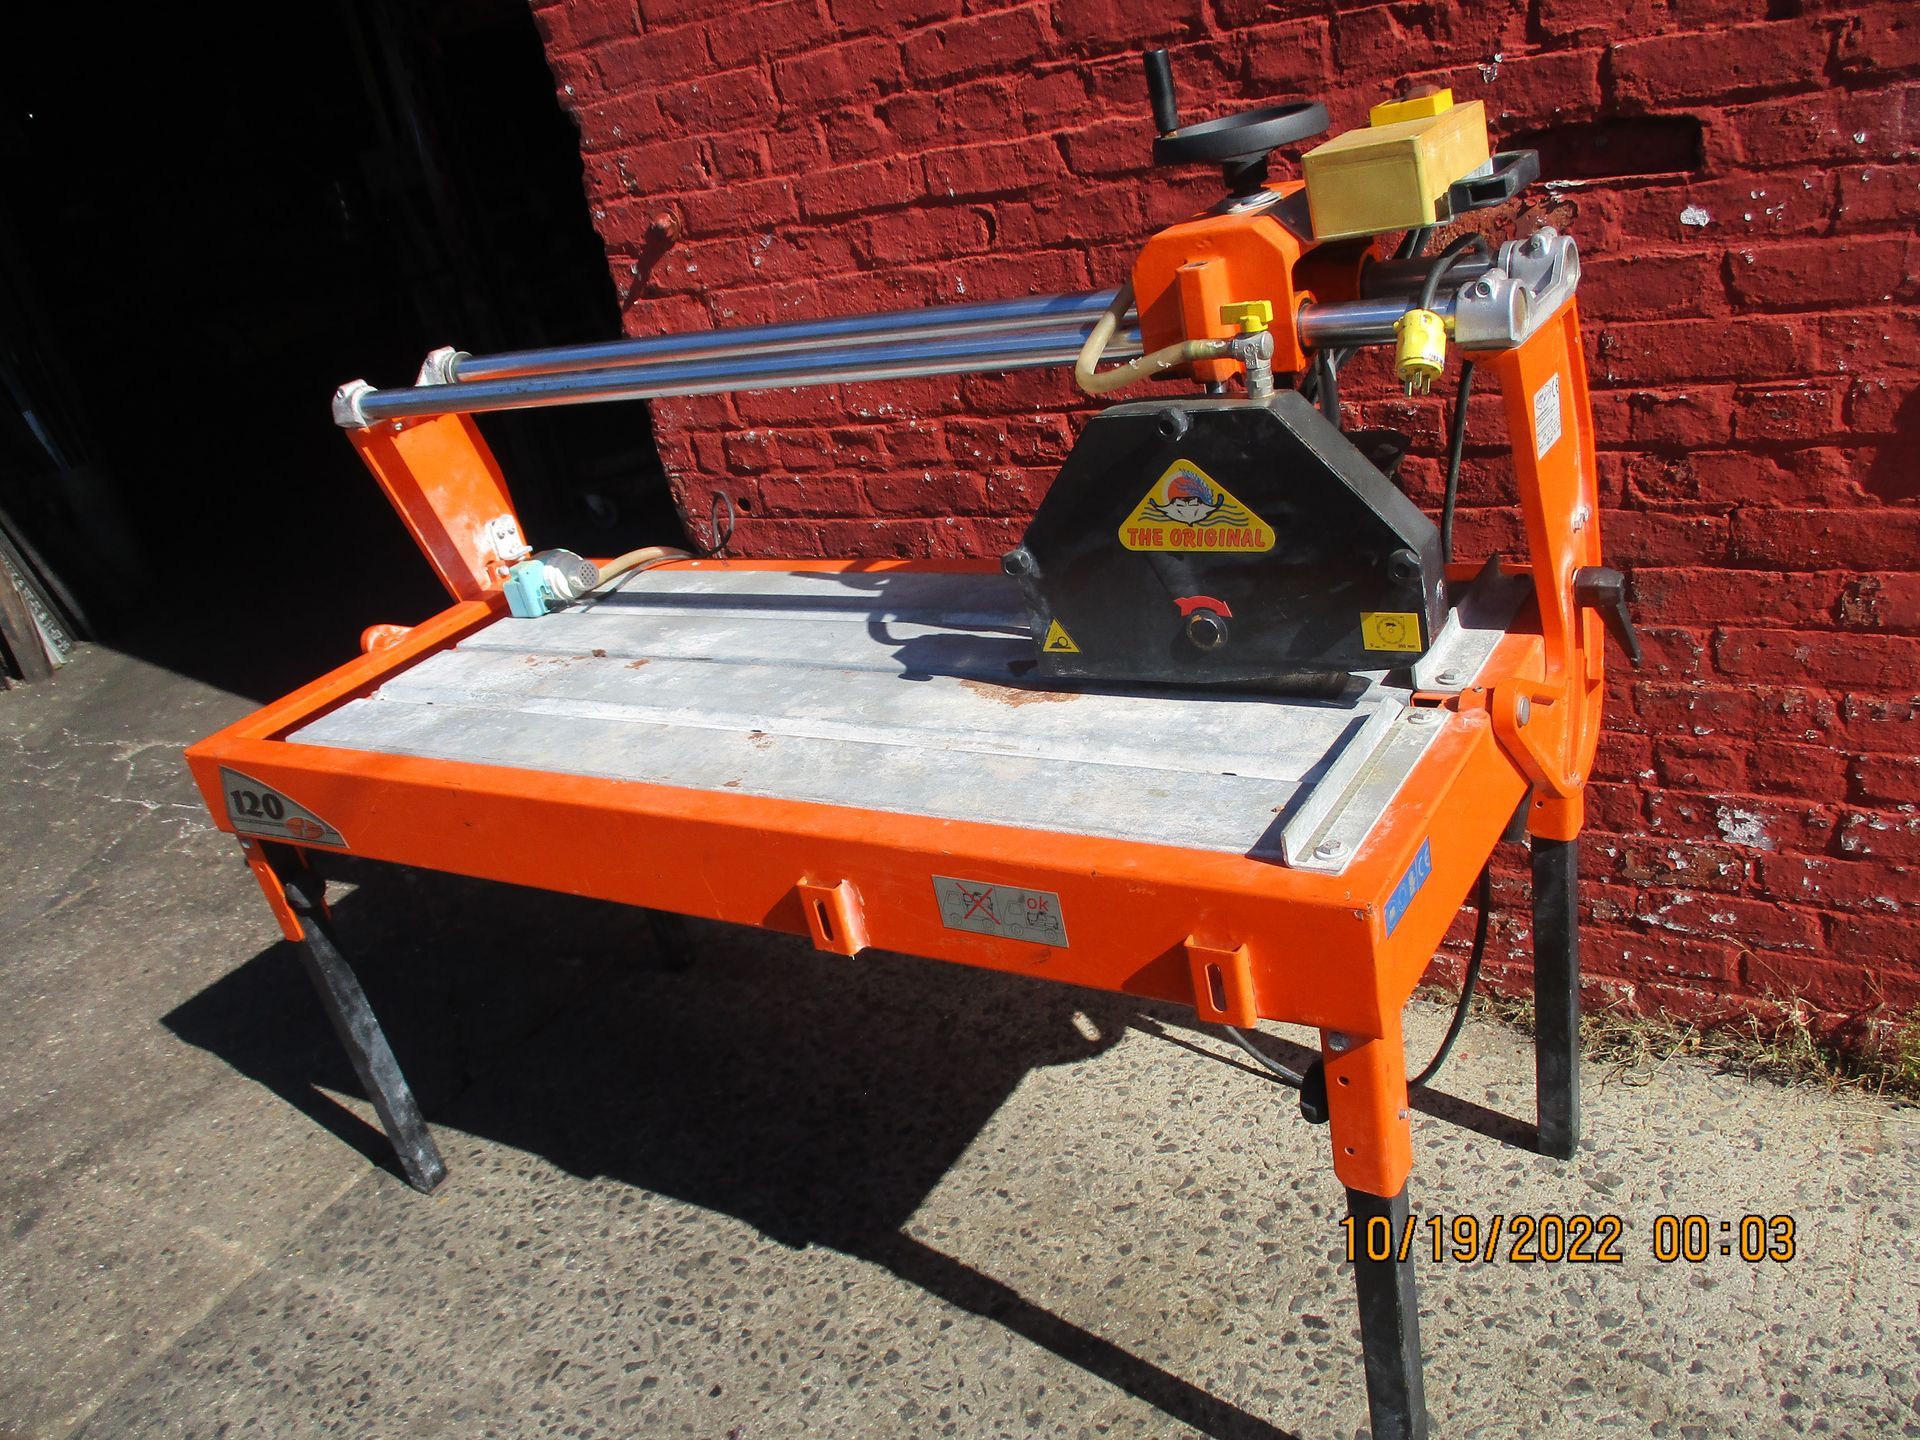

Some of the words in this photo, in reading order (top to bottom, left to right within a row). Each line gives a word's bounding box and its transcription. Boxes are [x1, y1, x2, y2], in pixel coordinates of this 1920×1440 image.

[1127, 528, 1164, 546] THE
[1169, 528, 1266, 548] ORIGINAL
[230, 790, 284, 819] 120
